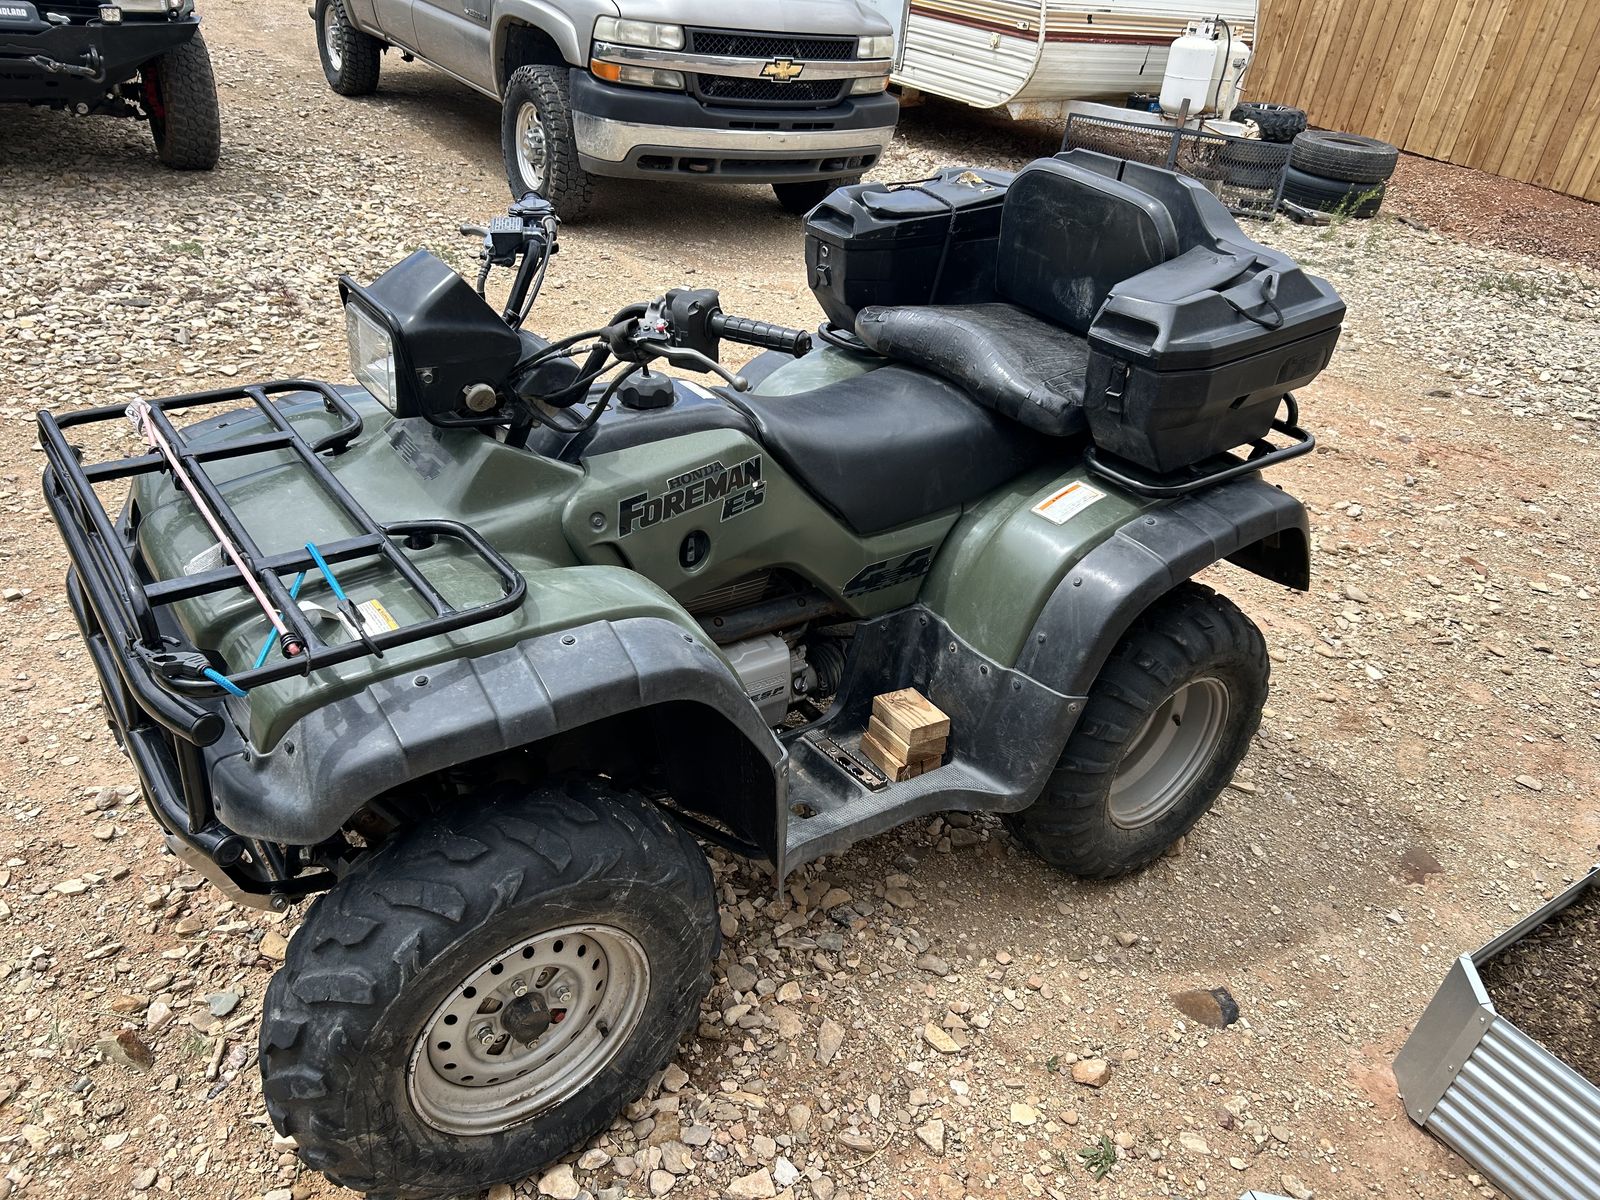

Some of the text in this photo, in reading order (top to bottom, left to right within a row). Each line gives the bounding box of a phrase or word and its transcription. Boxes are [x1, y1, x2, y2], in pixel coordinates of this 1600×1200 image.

[0, 7, 27, 17] DLAND
[667, 461, 725, 488] HONDA
[618, 454, 762, 538] FOREMAN
[720, 481, 767, 522] ES
